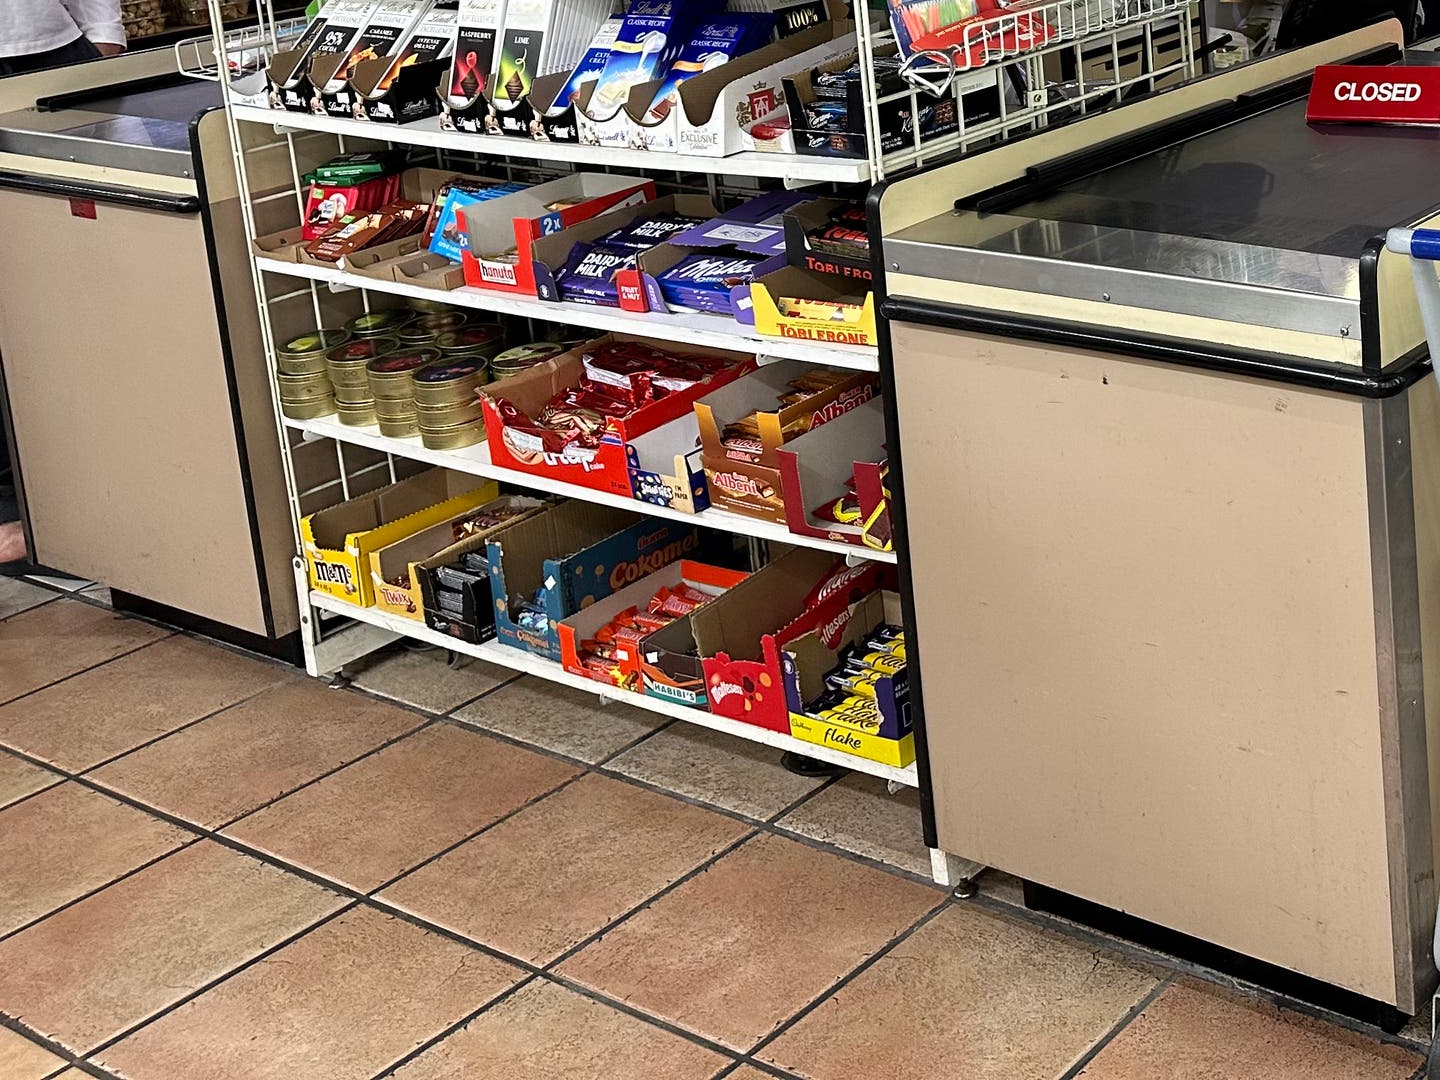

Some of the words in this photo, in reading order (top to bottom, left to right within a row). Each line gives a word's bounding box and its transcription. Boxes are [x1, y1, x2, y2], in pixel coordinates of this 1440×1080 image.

[628, 18, 650, 26] CLASSIC
[650, 18, 665, 28] RECIPE
[786, 6, 819, 30] 100%
[370, 28, 394, 36] CARAMEL
[460, 30, 493, 40] RASPBERRY
[322, 32, 346, 46] 95%
[417, 38, 440, 46] INTENSE
[514, 36, 530, 45] LIME
[691, 39, 712, 47] CLASSIC
[712, 40, 731, 48] RECIPE
[1334, 82, 1422, 102] CLOSED
[680, 132, 718, 144] EXCLUSIVE
[631, 226, 664, 238] MILK
[640, 220, 682, 232] DAIRY
[582, 253, 622, 266] DAIRY
[480, 261, 515, 282] hanuta
[575, 262, 608, 278] MILK
[678, 259, 755, 279] Milka
[621, 285, 638, 294] FRUIT
[628, 290, 640, 300] NUT
[776, 322, 868, 345] TOBLERONE
[590, 462, 605, 470] cake
[713, 472, 758, 496] Albeni
[674, 491, 688, 501] PAPER
[608, 528, 698, 590] Cokomel
[516, 630, 550, 649] Cokomel
[654, 684, 696, 702] HABIBI'S
[711, 682, 744, 704] Maltesers
[824, 728, 862, 750] flake
